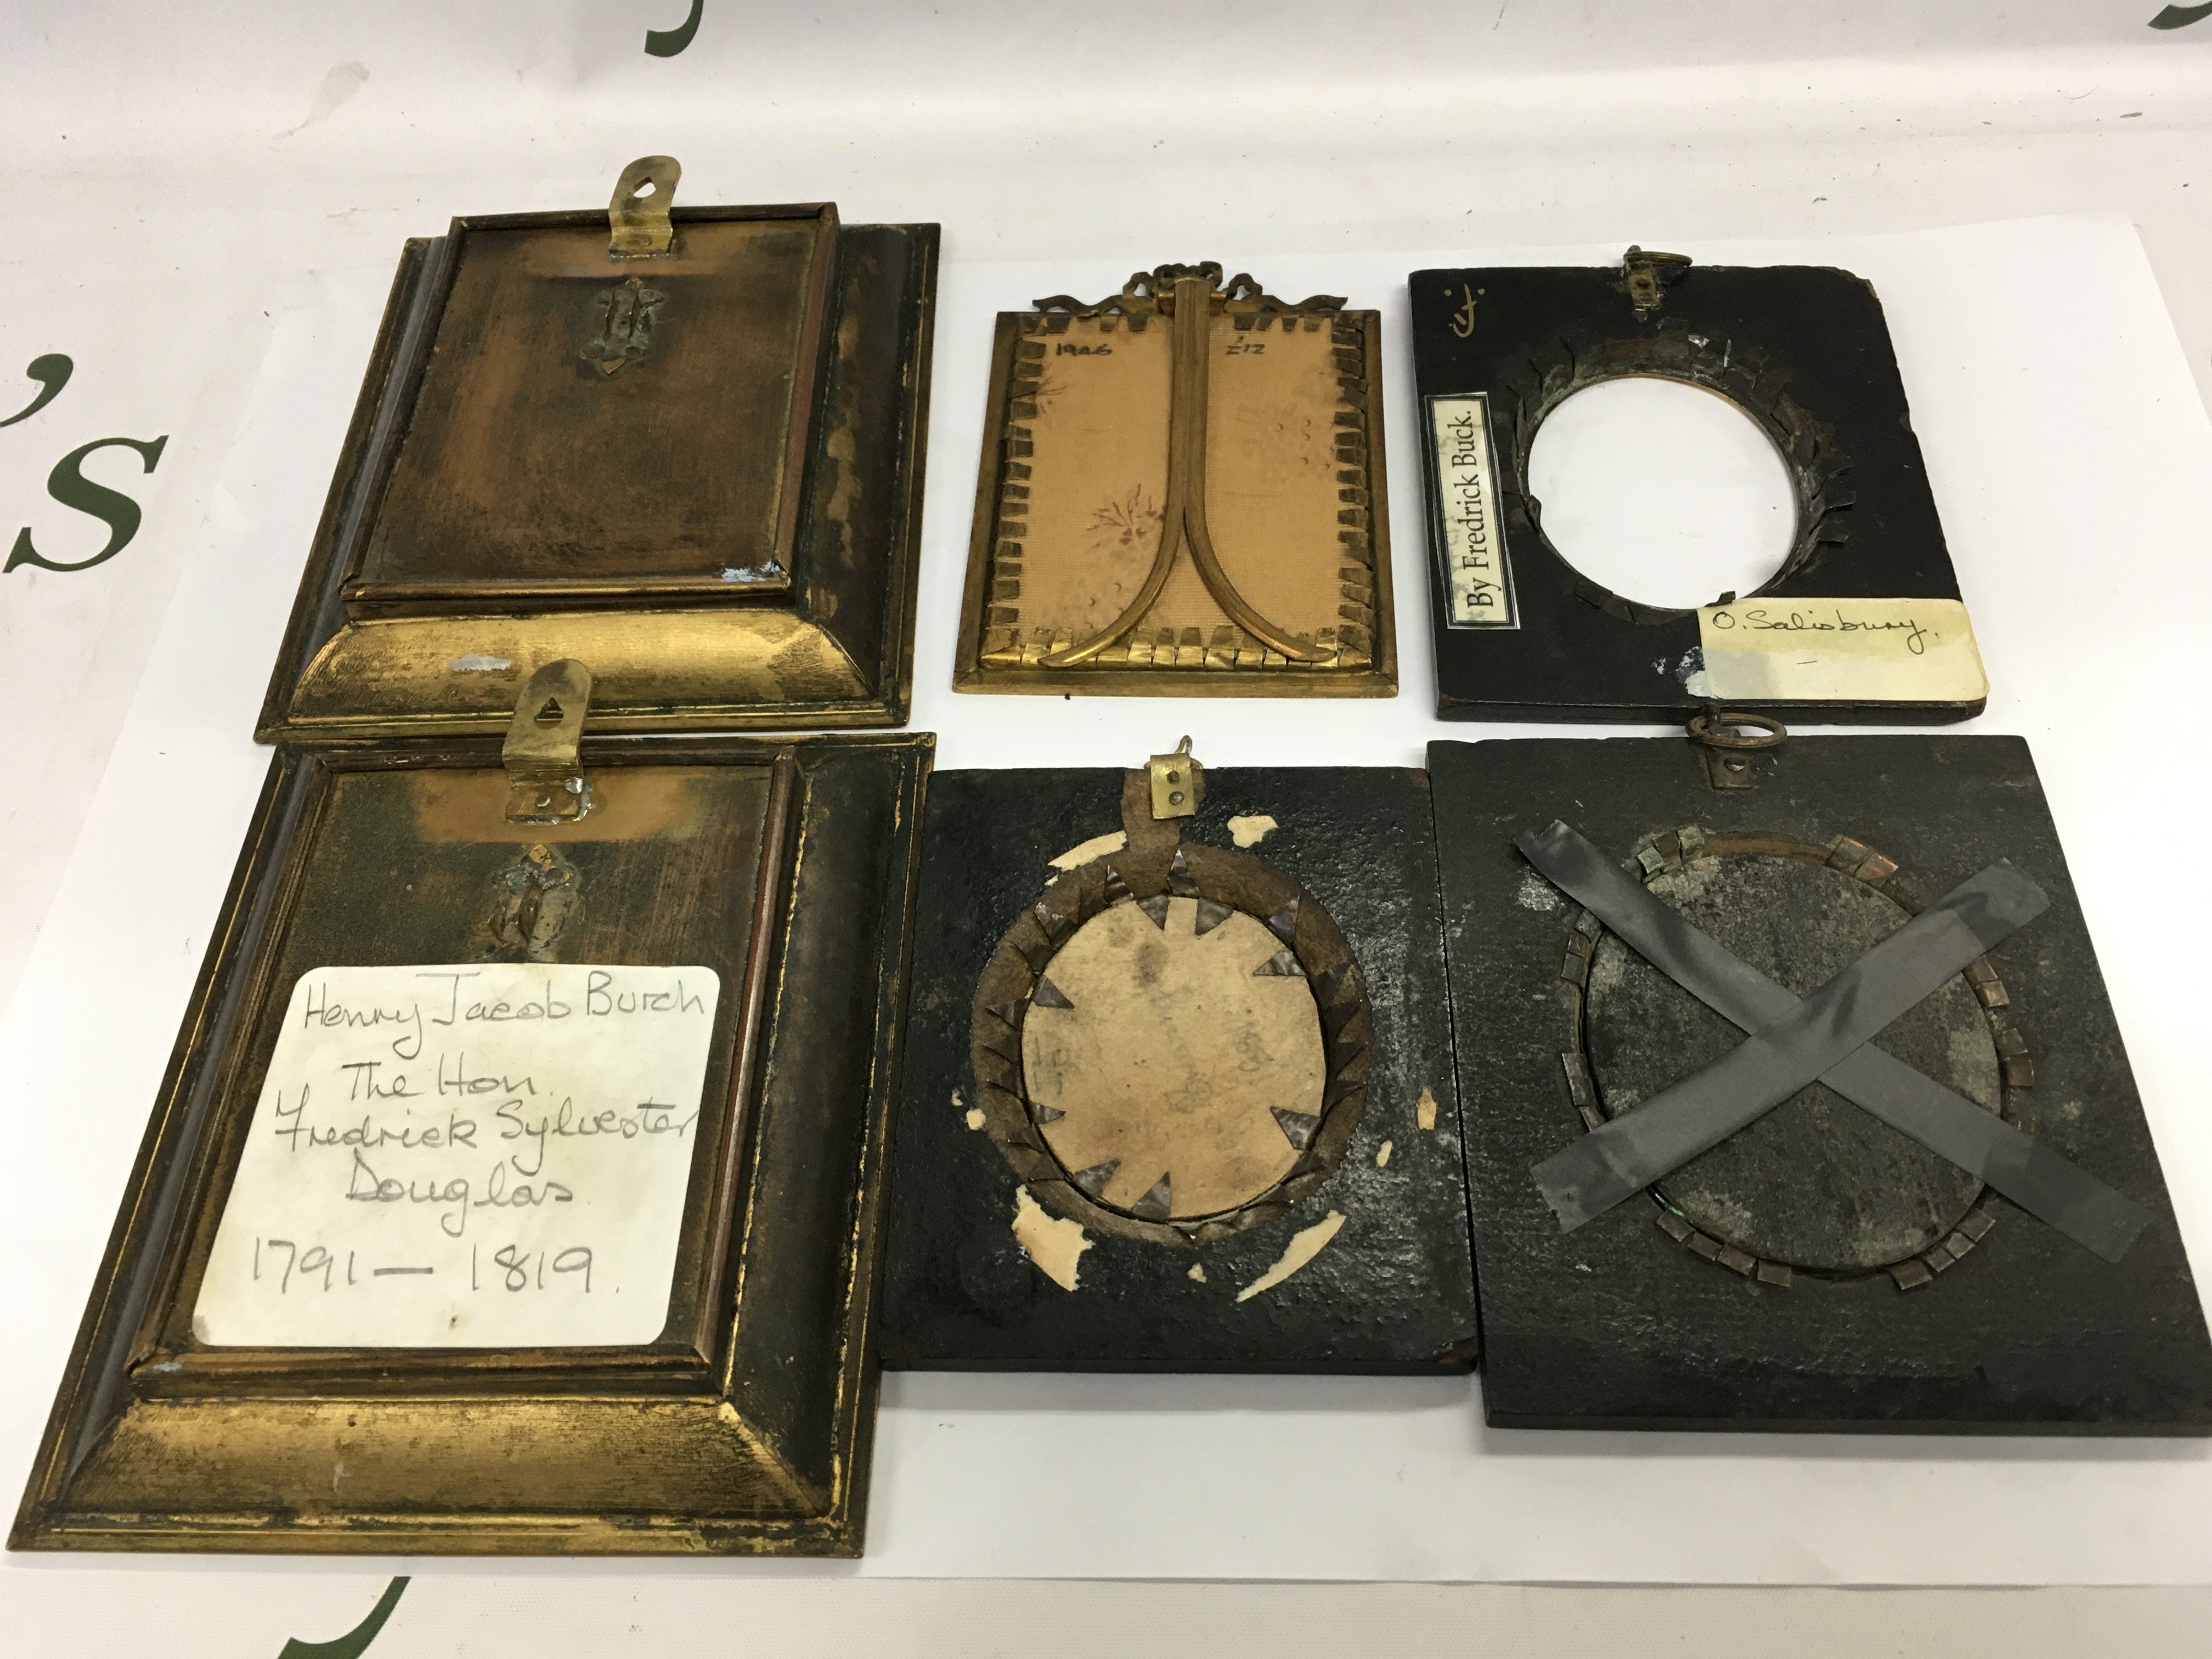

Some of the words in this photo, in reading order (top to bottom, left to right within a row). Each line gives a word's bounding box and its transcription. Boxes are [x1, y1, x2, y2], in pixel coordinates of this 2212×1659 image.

[1447, 410, 1477, 467] Buck.
[1453, 473, 1489, 570] Fredrick
[1466, 577, 1502, 608] By
[304, 981, 422, 1060] Henry
[415, 972, 572, 1025] Jacob
[587, 970, 704, 1016] Burch
[341, 1061, 426, 1101] The
[275, 1082, 477, 1152] Fredrick
[496, 1096, 699, 1176] Sylvester
[345, 1147, 573, 1238] Douglas
[253, 1237, 356, 1294] 1791
